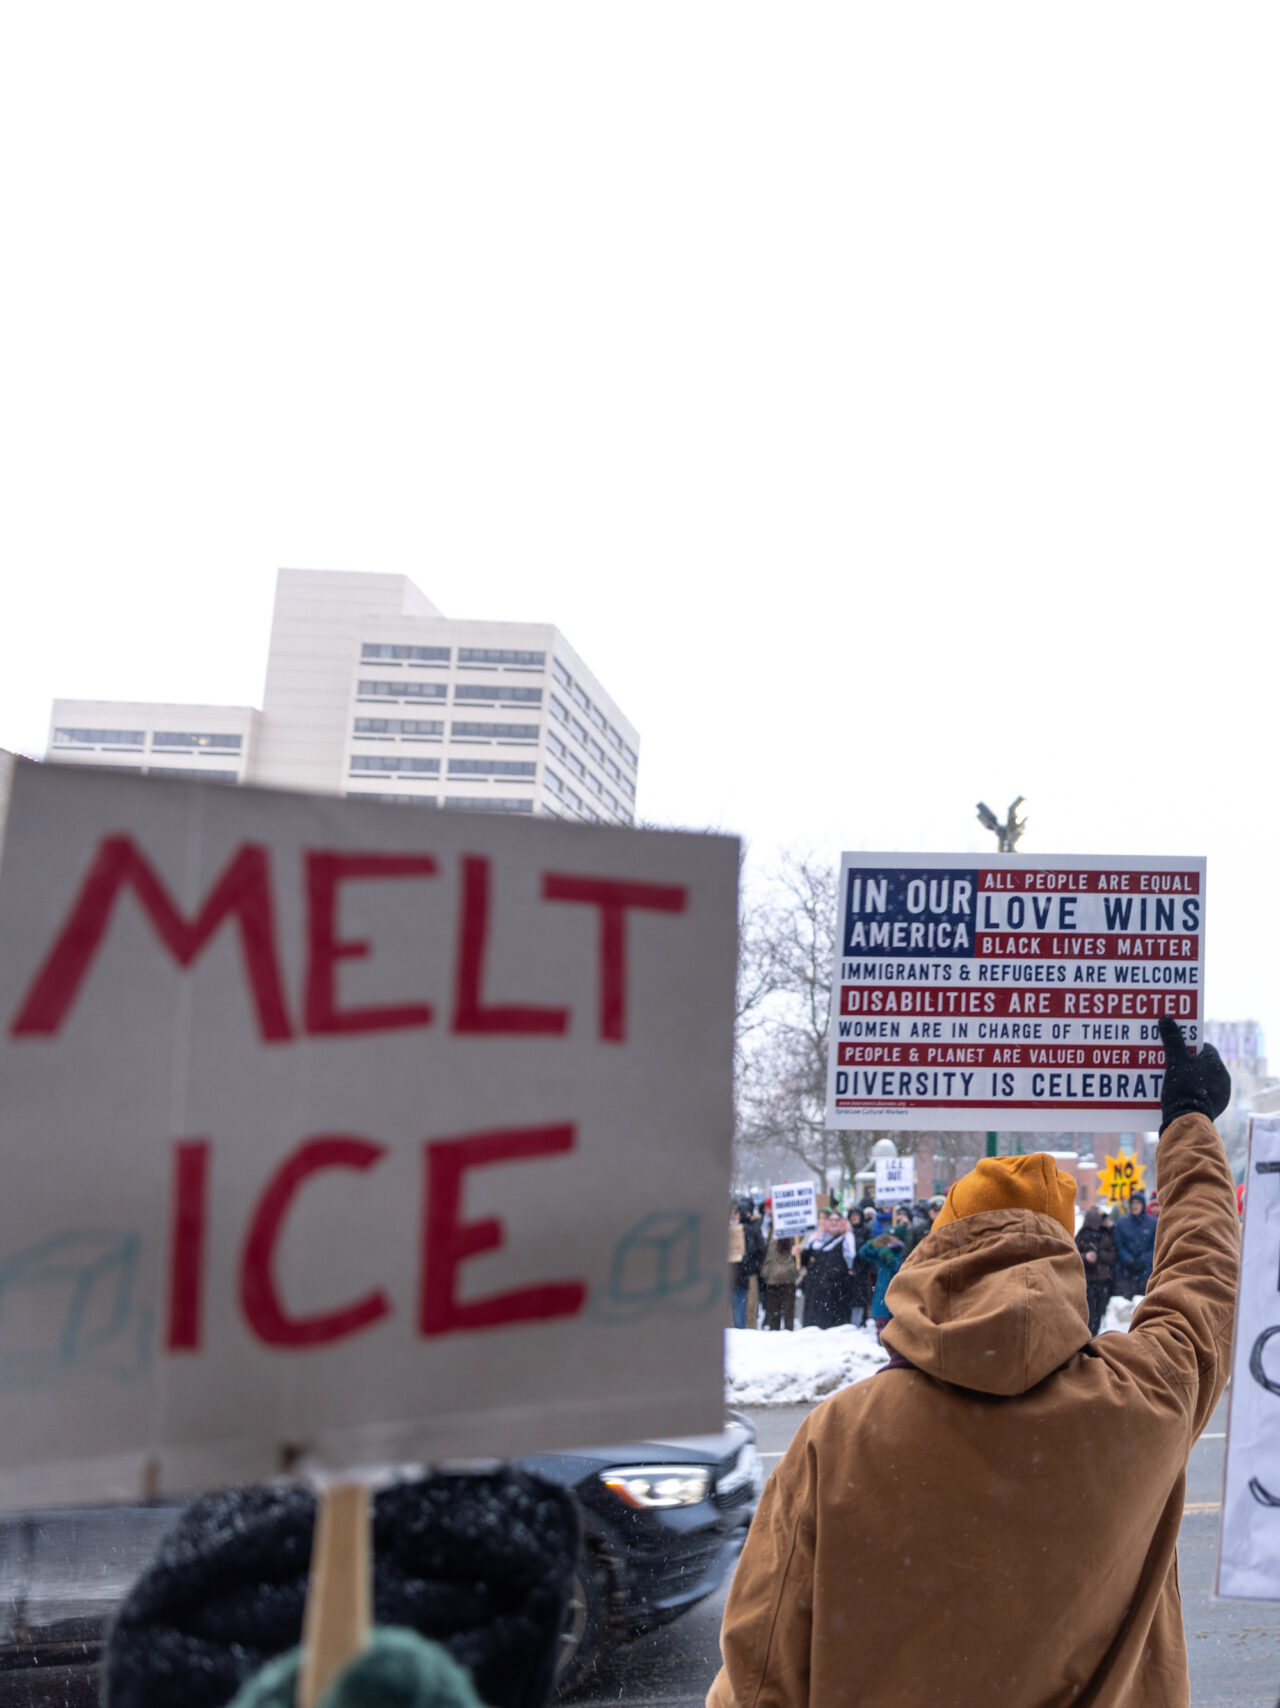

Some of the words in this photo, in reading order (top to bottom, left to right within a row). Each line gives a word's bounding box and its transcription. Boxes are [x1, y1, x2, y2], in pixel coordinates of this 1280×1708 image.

[984, 873, 1015, 889] ALL
[1025, 873, 1088, 890] PEOPLE
[1098, 875, 1130, 890] ARE
[1140, 875, 1192, 892] EQUAL
[852, 878, 887, 914] IN
[907, 879, 972, 915] OUR
[983, 896, 1078, 930] LOVE
[1103, 897, 1200, 931] WINS
[8, 832, 690, 1046] MELT
[850, 922, 969, 949] AMERICA
[982, 936, 1041, 954] BLACK
[1053, 938, 1106, 954] LIVES
[1117, 938, 1192, 956] MATTER
[841, 962, 951, 981] IMMIGRANTS
[959, 964, 971, 981] &
[979, 964, 1066, 982] REFUGEES
[1073, 965, 1106, 982] ARE
[1115, 966, 1199, 984] WELCOME
[848, 991, 995, 1012] DISABILITIES
[1008, 992, 1050, 1013] ARE
[1064, 993, 1191, 1015] RESPECTED
[839, 1021, 900, 1038] WOMEN
[911, 1022, 942, 1038] ARE
[952, 1022, 968, 1038] IN
[978, 1022, 1042, 1039] CHARGE
[1052, 1024, 1071, 1039] OF
[1082, 1024, 1130, 1040] THEIR
[845, 1048, 901, 1062] PEOPLE
[909, 1048, 919, 1062] &
[928, 1048, 984, 1062] PLANET
[992, 1049, 1021, 1063] ARE
[1029, 1049, 1086, 1064] VALUED
[1092, 1049, 1131, 1064] OVER
[836, 1071, 974, 1096] DIVERSITY
[992, 1072, 1014, 1096] IS
[1113, 1161, 1133, 1181] NO
[165, 1122, 590, 1352] ICE
